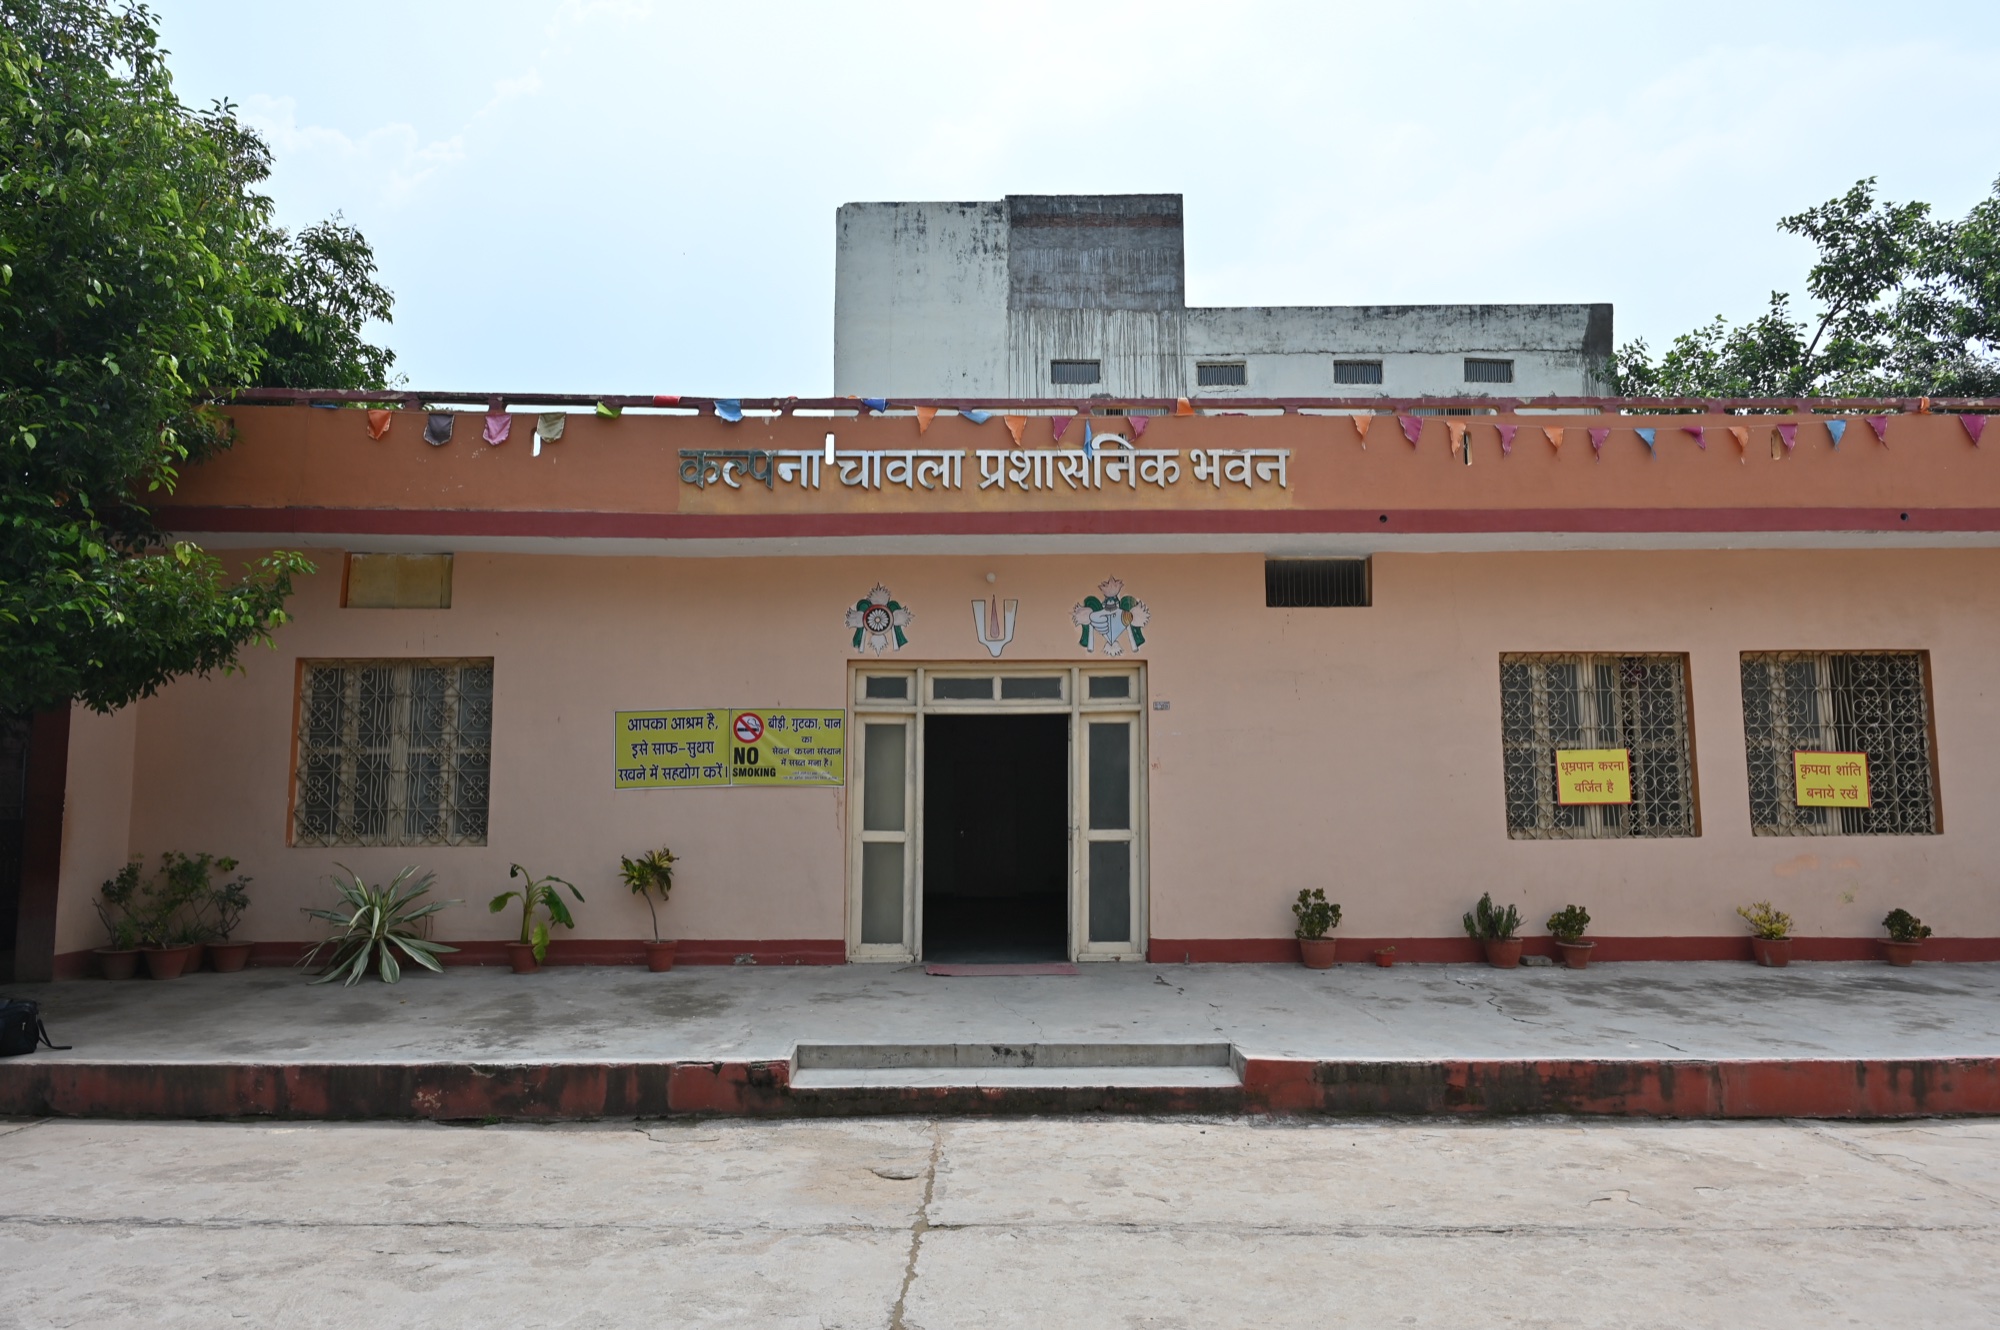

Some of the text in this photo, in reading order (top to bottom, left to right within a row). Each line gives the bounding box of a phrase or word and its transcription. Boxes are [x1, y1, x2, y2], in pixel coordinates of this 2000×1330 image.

[679, 433, 1290, 491] कल्पना चावला प्रशासनिक भवन
[627, 712, 718, 731] आपका आश्रम है,
[791, 718, 821, 732] गुटका,
[824, 718, 841, 729] पान
[631, 739, 714, 759] इसे साफ-सुथरा
[733, 747, 759, 765] NO
[772, 746, 790, 755] सेवन
[808, 759, 821, 767] मना
[1561, 761, 1624, 775] धूम्रपान करना
[1799, 762, 1861, 779] कृपया शांति
[618, 764, 646, 781] रखने
[649, 763, 659, 780] में
[661, 763, 700, 781] सहयोग
[732, 767, 776, 778] SMOKING
[1574, 778, 1614, 793] वर्जित है
[1806, 784, 1858, 800] बनाये रखें
